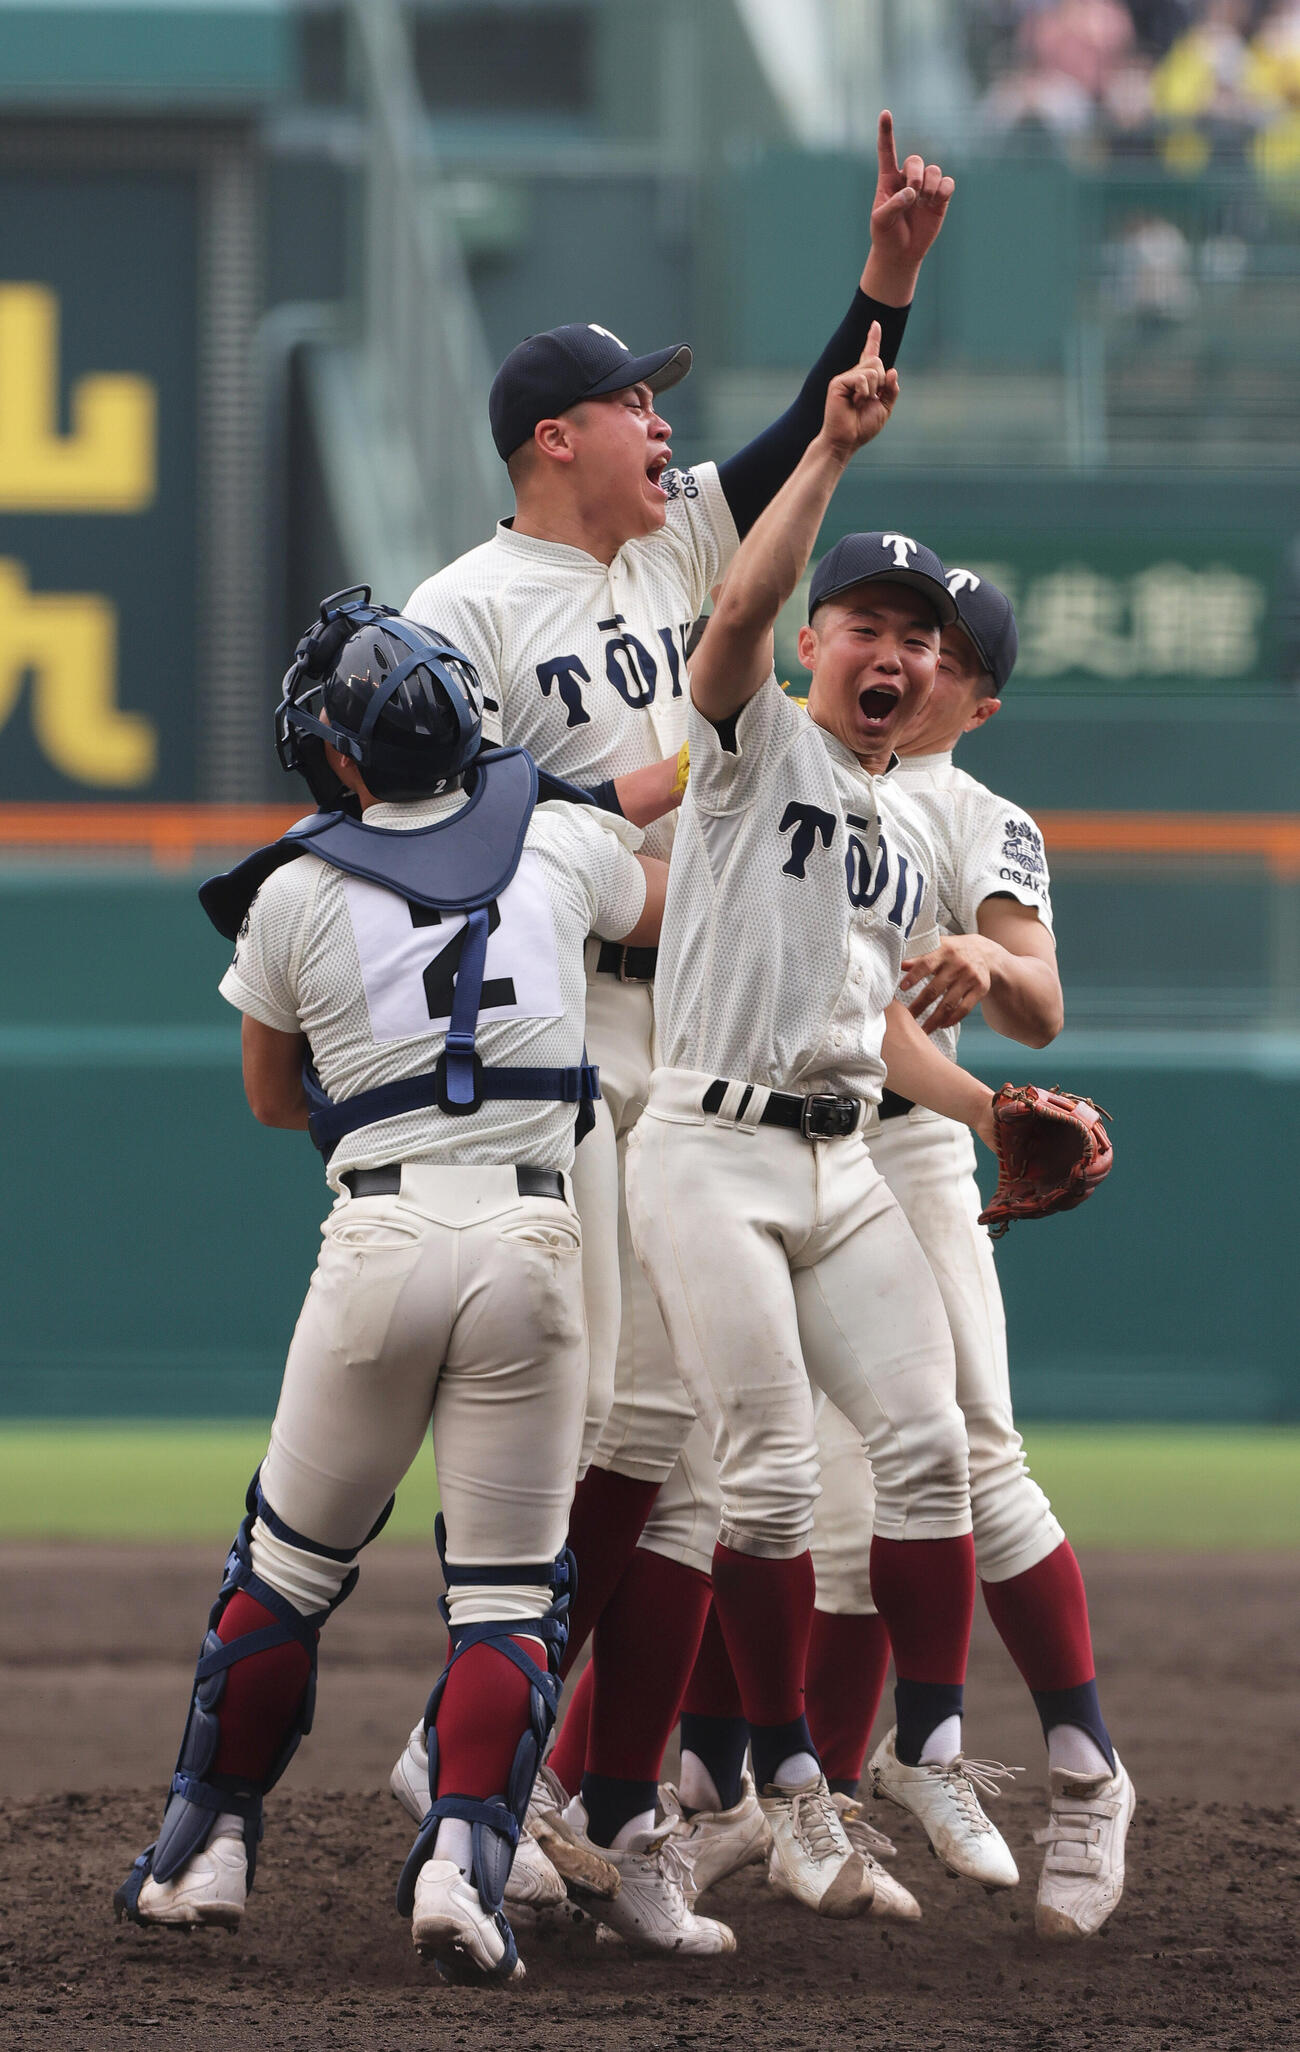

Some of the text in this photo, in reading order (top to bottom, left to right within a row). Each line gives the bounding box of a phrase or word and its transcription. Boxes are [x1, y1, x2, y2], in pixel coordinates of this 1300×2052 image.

[881, 534, 918, 568] T
[944, 568, 981, 599] T
[433, 778, 447, 794] 2
[407, 899, 517, 1020] 2
